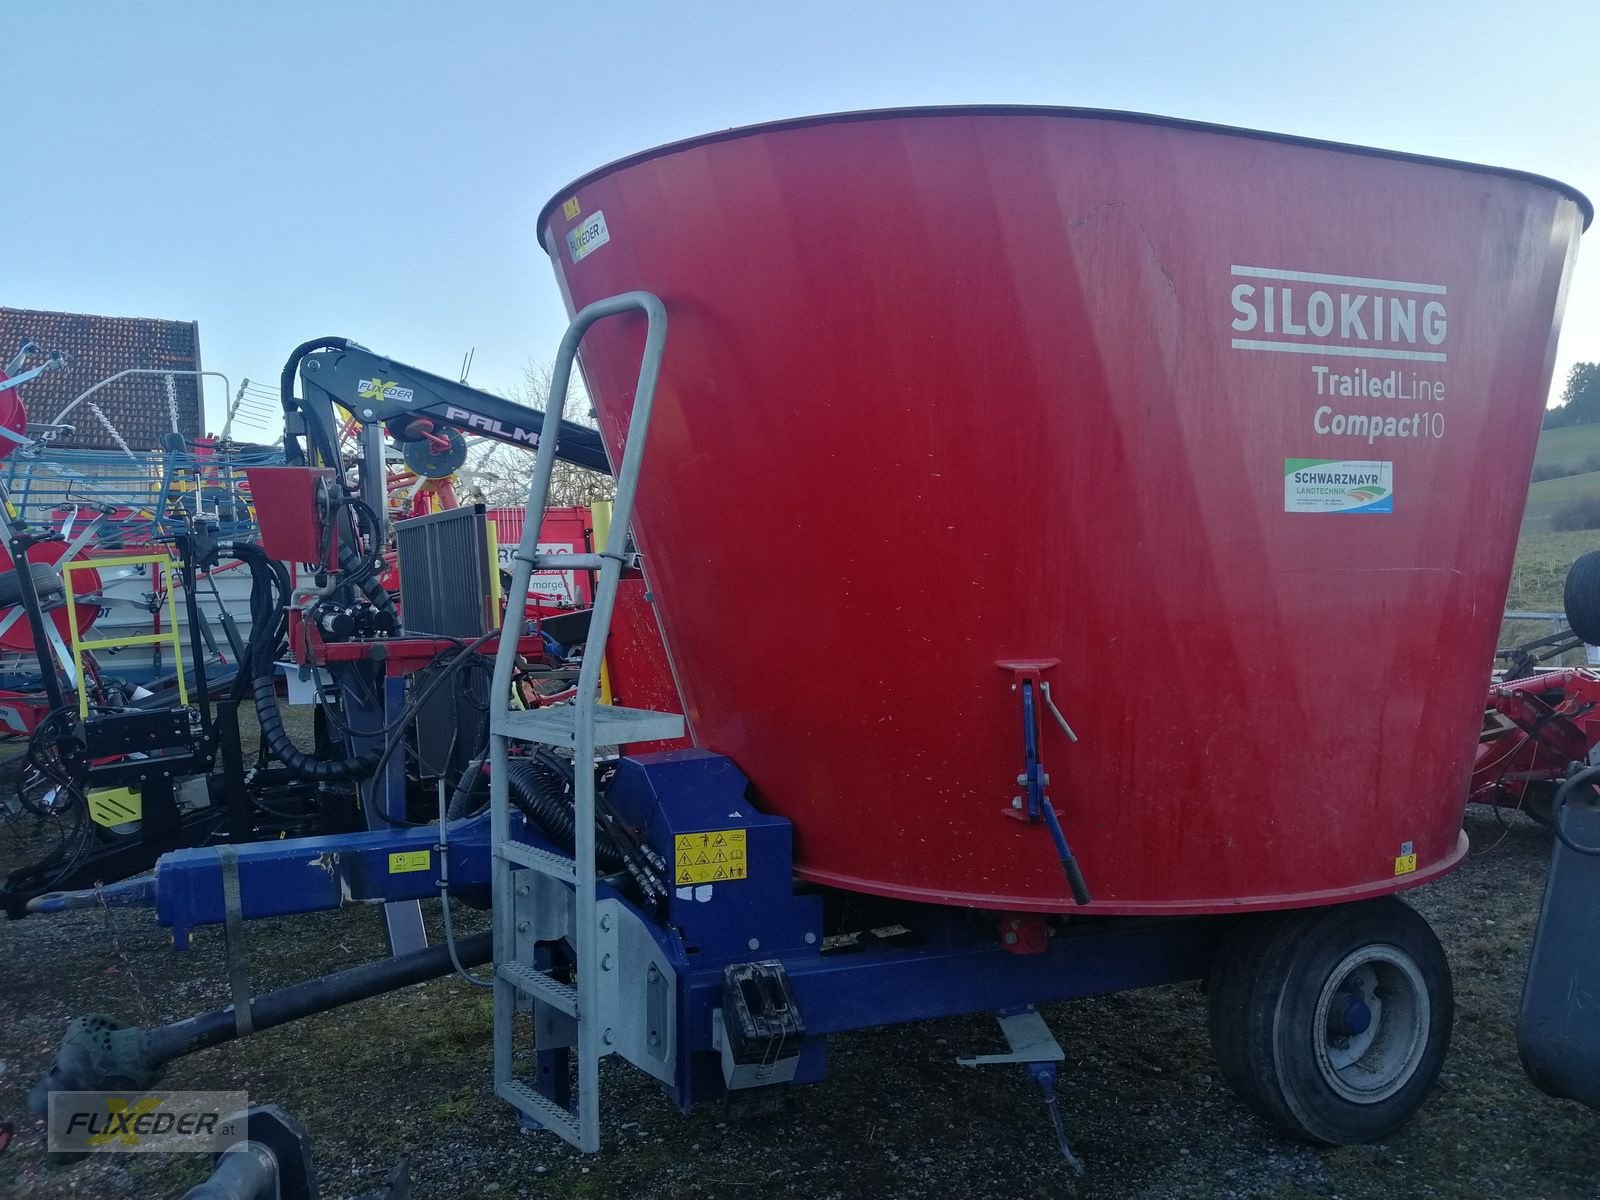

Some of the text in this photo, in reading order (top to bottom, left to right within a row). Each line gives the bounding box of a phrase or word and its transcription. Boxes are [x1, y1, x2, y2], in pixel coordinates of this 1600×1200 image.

[1231, 284, 1447, 345] SILOKING
[359, 382, 413, 399] FLIXEDER
[1312, 365, 1445, 401] TrailedLine
[1294, 472, 1379, 485] SCHWARZMAYR
[1296, 487, 1346, 495] LANDTECHNIK
